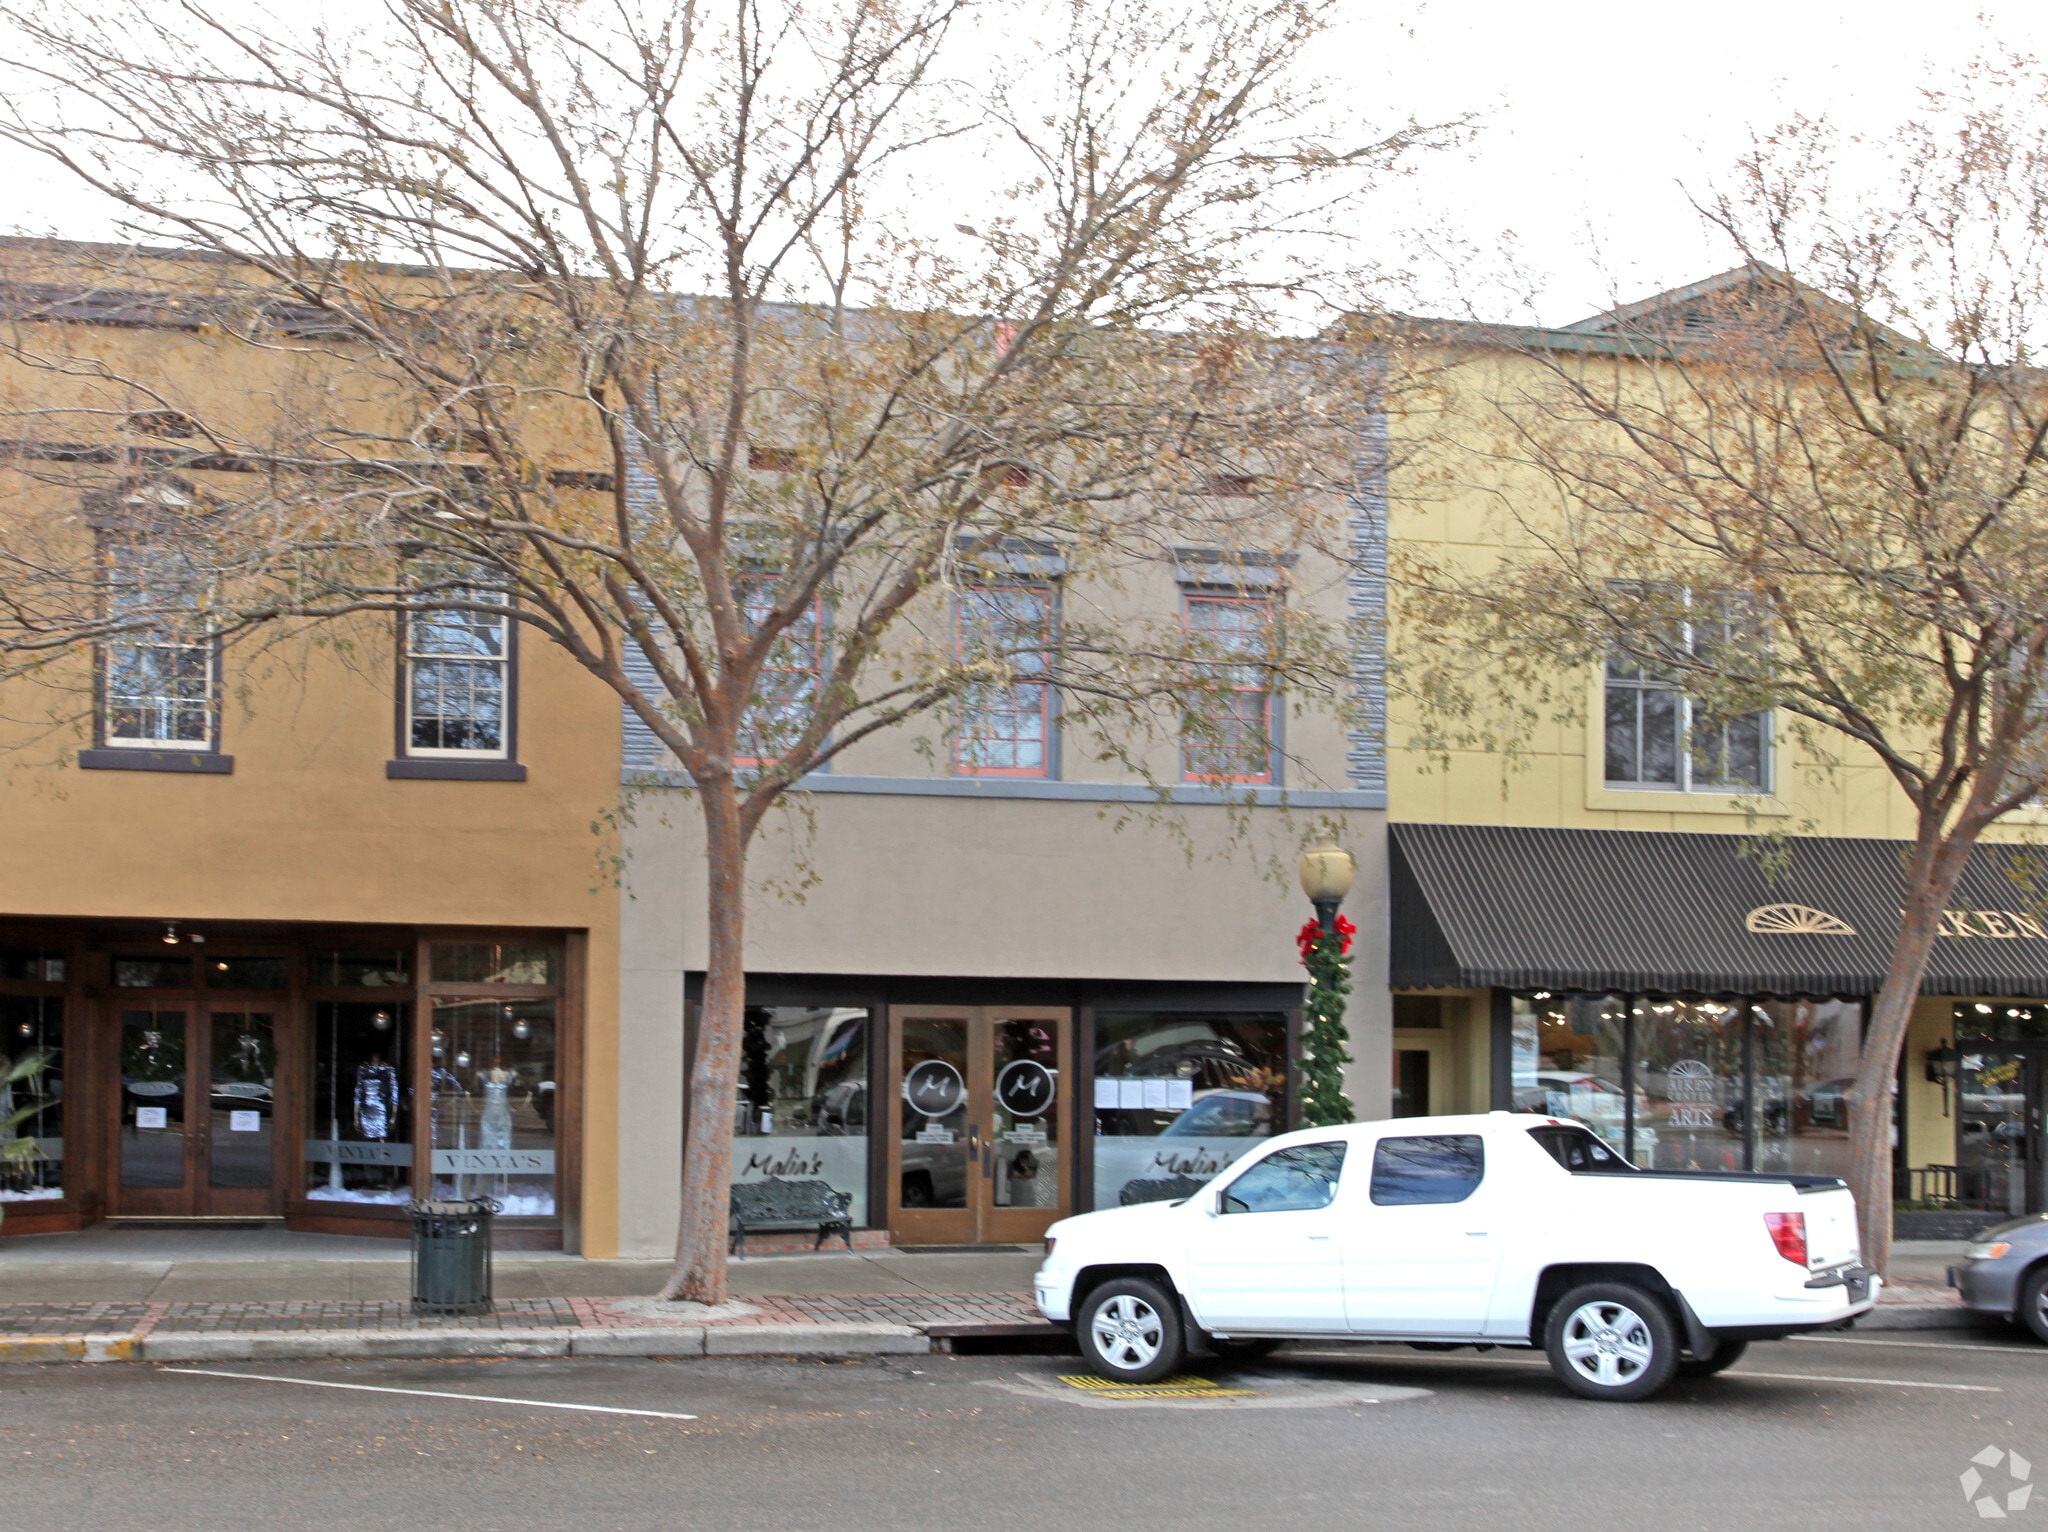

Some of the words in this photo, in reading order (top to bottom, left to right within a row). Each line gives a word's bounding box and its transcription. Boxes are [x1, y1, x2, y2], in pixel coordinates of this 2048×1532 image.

[1900, 908, 2048, 939] IKEN
[917, 1074, 951, 1097] M
[1008, 1074, 1041, 1097] M
[1667, 1108, 1714, 1127] ARTS
[446, 1154, 542, 1169] VINYA'S
[741, 1147, 823, 1177] Malia's
